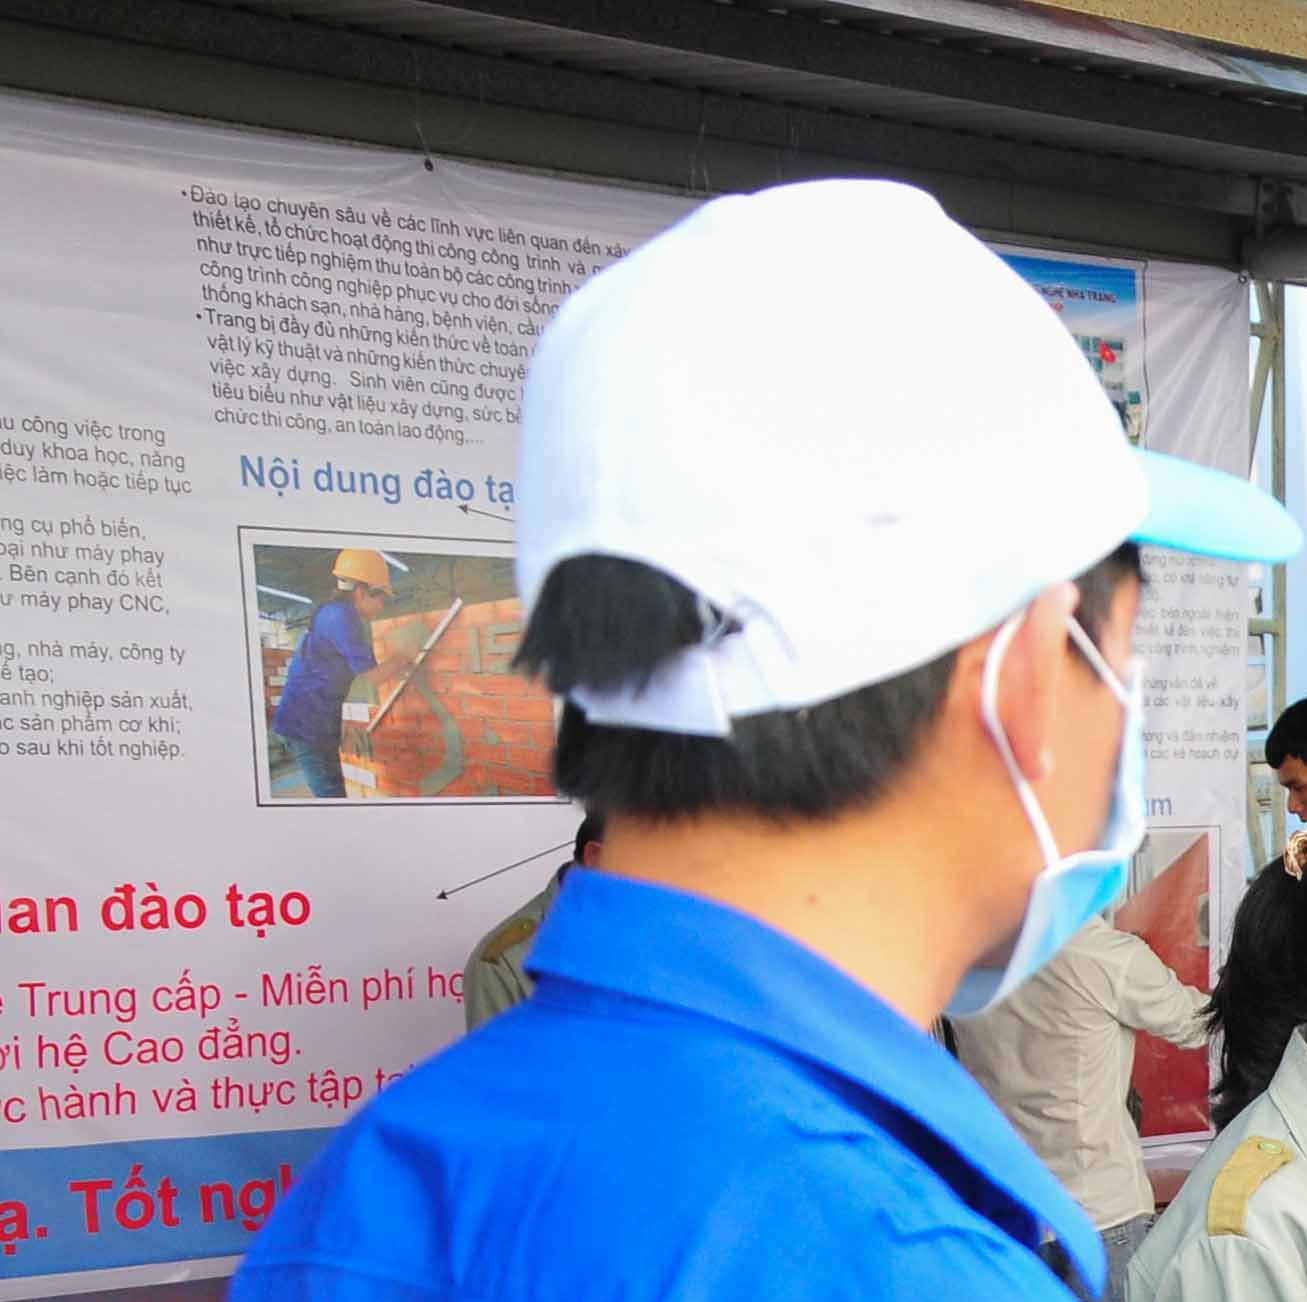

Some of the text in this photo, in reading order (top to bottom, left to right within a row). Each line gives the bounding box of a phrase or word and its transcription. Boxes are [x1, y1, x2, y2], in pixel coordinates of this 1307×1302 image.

[192, 209, 231, 232] thiết
[285, 222, 329, 243] chức
[331, 227, 368, 248] hoạt
[371, 232, 412, 258] động
[416, 239, 434, 257] thi
[438, 243, 477, 264] công
[481, 248, 519, 270] công
[267, 197, 330, 222] chuyên
[335, 206, 366, 225] sâu
[397, 213, 426, 233] các
[464, 225, 494, 246] vực
[499, 227, 525, 246] liên
[530, 233, 568, 253] quan
[572, 236, 601, 256] đến
[197, 236, 535, 295] như trực tiếp nghiệm thu bộ các công
[200, 261, 243, 285] công
[291, 272, 332, 296] công
[337, 279, 393, 302] nghiệp
[396, 285, 437, 305] phục
[439, 291, 458, 308] vụ
[462, 291, 490, 310] cho
[256, 289, 307, 312] khách
[433, 309, 472, 329] bệnh
[204, 307, 256, 334] Trang
[260, 313, 276, 335] bị
[339, 326, 393, 348] những
[397, 328, 430, 348] kiến
[433, 334, 469, 353] thức
[207, 333, 234, 354] vật
[278, 340, 321, 363] thuật
[347, 349, 400, 372] những
[403, 352, 436, 372] kiến
[439, 357, 475, 376] thức
[209, 359, 246, 379] việc
[250, 364, 281, 384] xây
[349, 369, 386, 391] Sinh
[391, 376, 424, 394] viên
[430, 379, 469, 401] cũng
[474, 383, 516, 402] được
[212, 383, 244, 402] tiêu
[248, 384, 285, 405] biểu
[289, 390, 324, 409] như
[328, 391, 353, 411] vật
[357, 395, 386, 414] liệu
[390, 399, 418, 419] xây
[22, 416, 166, 447] công việc trong
[214, 407, 258, 426] chức
[261, 410, 282, 428] thi
[335, 419, 356, 434] an
[397, 421, 421, 439] lao
[1, 438, 134, 467] duy khoa học,
[74, 469, 121, 491] hoặc
[125, 470, 159, 494] tiếp
[165, 476, 192, 496] tục
[239, 454, 475, 505] Nội dung đào
[31, 518, 53, 537] cụ
[60, 514, 95, 538] phổ
[31, 541, 166, 568] như máy phay
[10, 563, 48, 583] Bên
[55, 567, 100, 588] cạnh
[106, 568, 130, 587] đó
[21, 592, 171, 616] máy phay CNC,
[28, 640, 64, 659] nhà
[119, 642, 164, 665] công
[170, 645, 186, 666] ty
[41, 689, 105, 712] nghiệp
[119, 718, 143, 733] cơ
[16, 735, 185, 761] sau khi tốt nghiệp.
[101, 880, 311, 938] đào tạo
[17, 982, 137, 1024] Trung
[153, 968, 221, 1018] cấp
[261, 964, 349, 1007] Miễn
[362, 966, 415, 1011] phí
[38, 1017, 302, 1075] hệ Cao đẳng.
[38, 1082, 136, 1121] hành
[152, 1078, 197, 1113] và
[211, 1076, 296, 1114] thực
[307, 1069, 363, 1109] tập
[69, 1164, 180, 1233] Tốt
